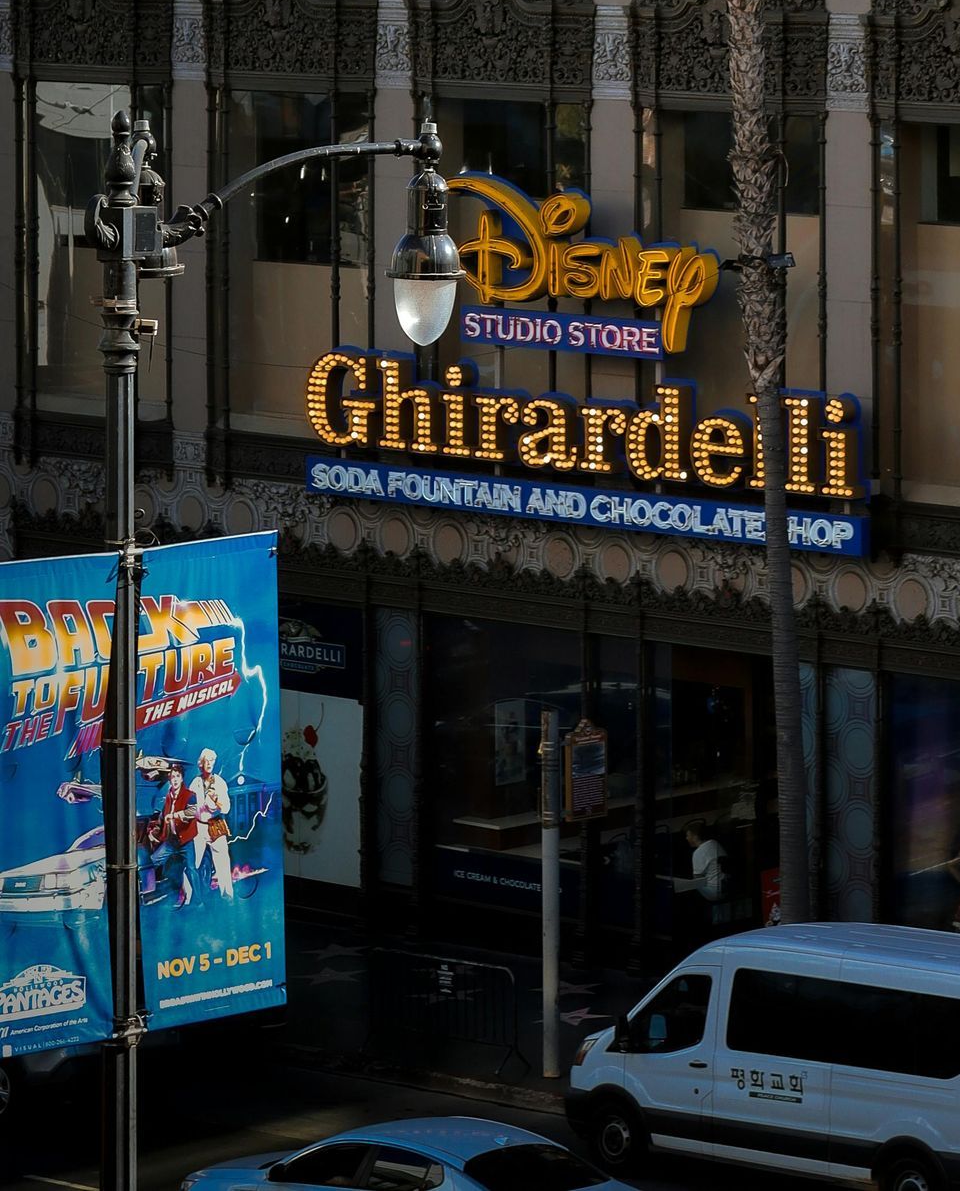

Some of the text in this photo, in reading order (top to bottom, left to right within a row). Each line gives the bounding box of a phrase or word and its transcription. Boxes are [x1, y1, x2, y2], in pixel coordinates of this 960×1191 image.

[446, 176, 720, 354] Disney
[464, 312, 661, 355] STUDIO STORE
[305, 351, 856, 498] Ghirardelli
[311, 462, 855, 550] SODA FOUNTAIN AND CHOCOLATE HOP
[0, 595, 201, 676] BACK
[12, 676, 57, 716] TO
[54, 637, 236, 735] FUTURE
[143, 679, 235, 724] THE MUSICAL
[3, 712, 54, 752] THE
[453, 869, 465, 879] ICE
[466, 871, 491, 883] CREAM
[499, 877, 542, 892] CHOCOLATE
[157, 955, 195, 980] NOV
[199, 953, 210, 972] 5
[226, 943, 261, 967] DEC
[264, 941, 272, 959] 1
[13, 979, 64, 993] HOLLYWOOD
[10, 1024, 33, 1036] American
[34, 1021, 62, 1032] Corporation
